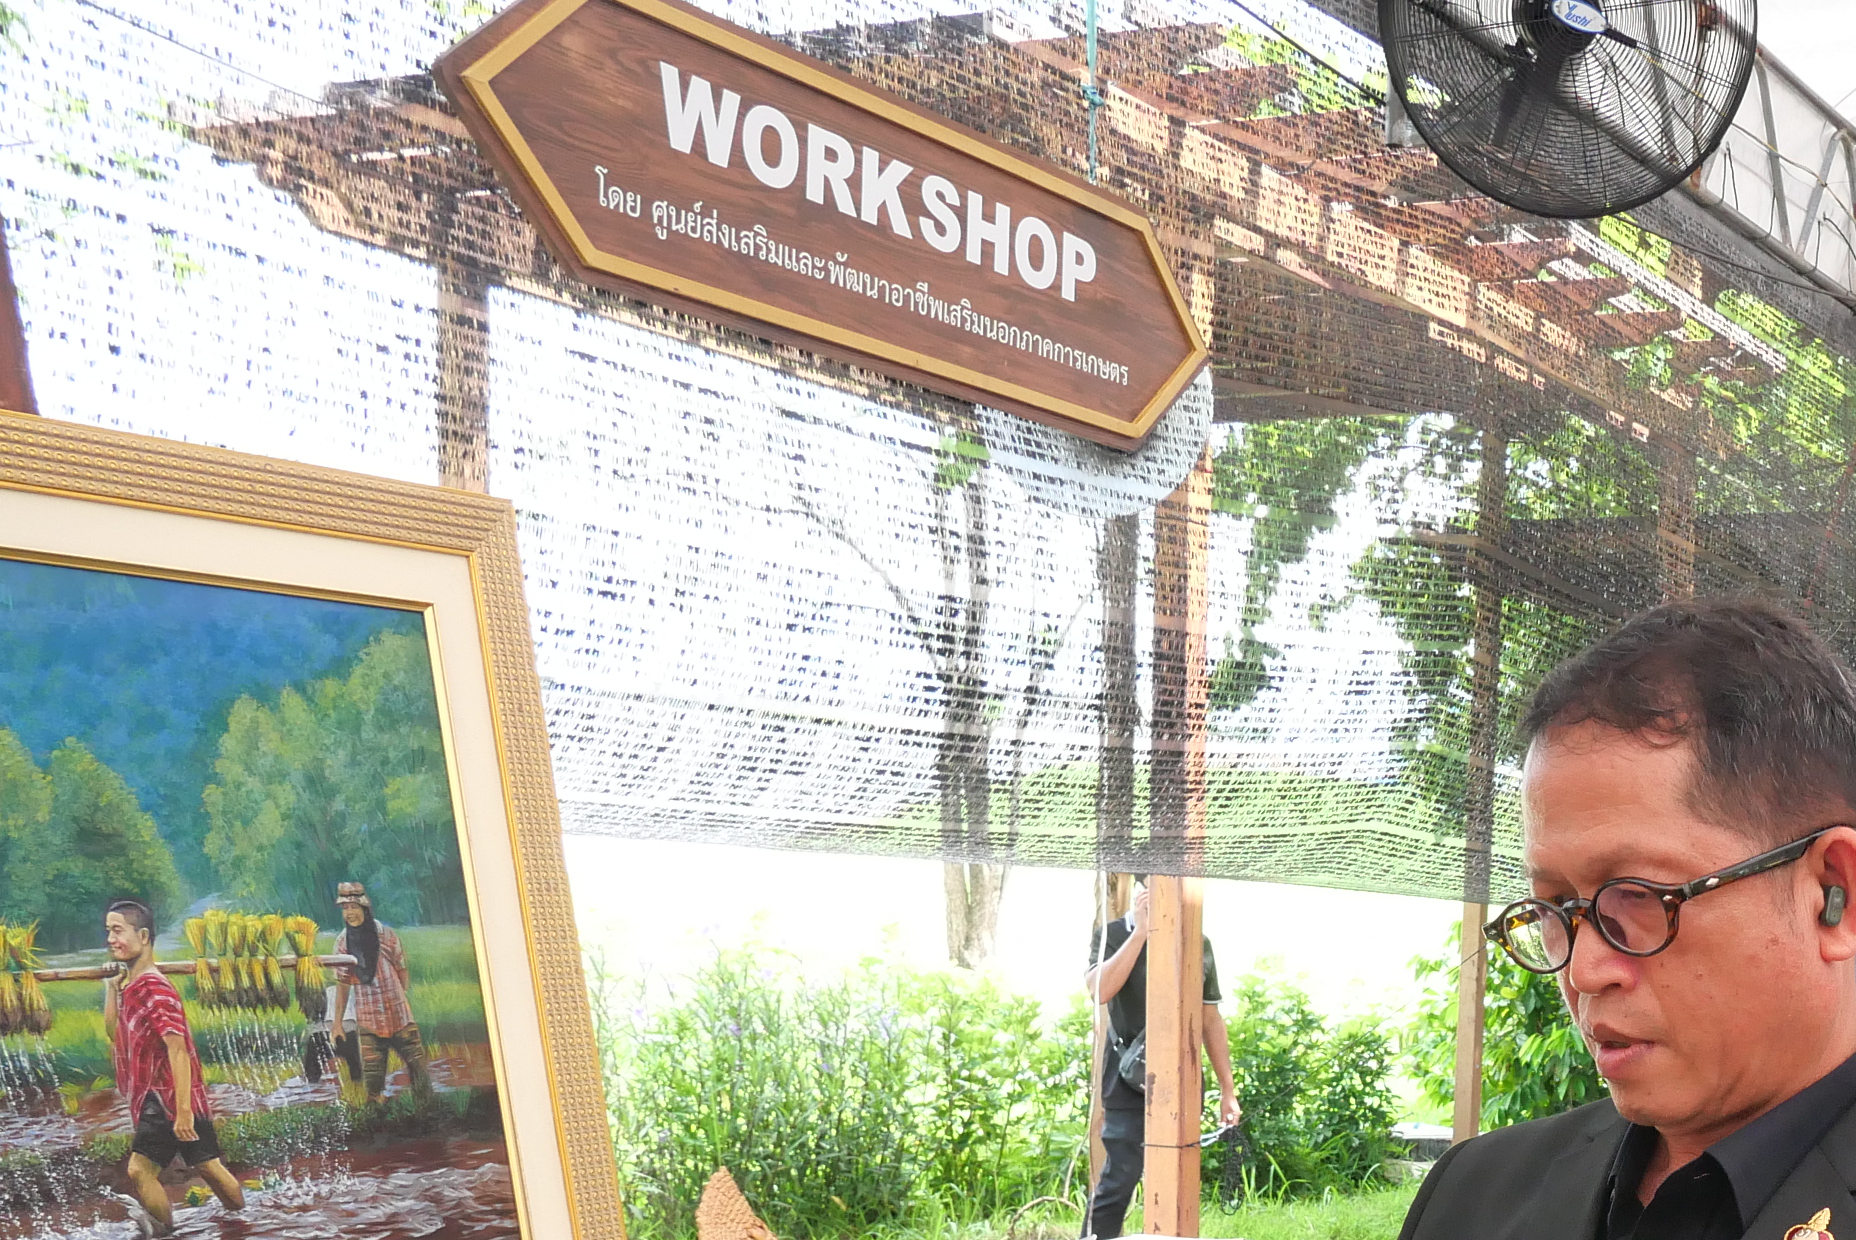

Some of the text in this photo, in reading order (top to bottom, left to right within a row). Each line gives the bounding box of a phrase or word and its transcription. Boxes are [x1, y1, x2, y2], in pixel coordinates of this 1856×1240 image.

[594, 165, 1129, 386] โดย ศูนย์ส่งเสริมและพัฒนาอาชีพเสริมนอกภาคการเกษตร
[659, 61, 1097, 302] WORKSHOP
